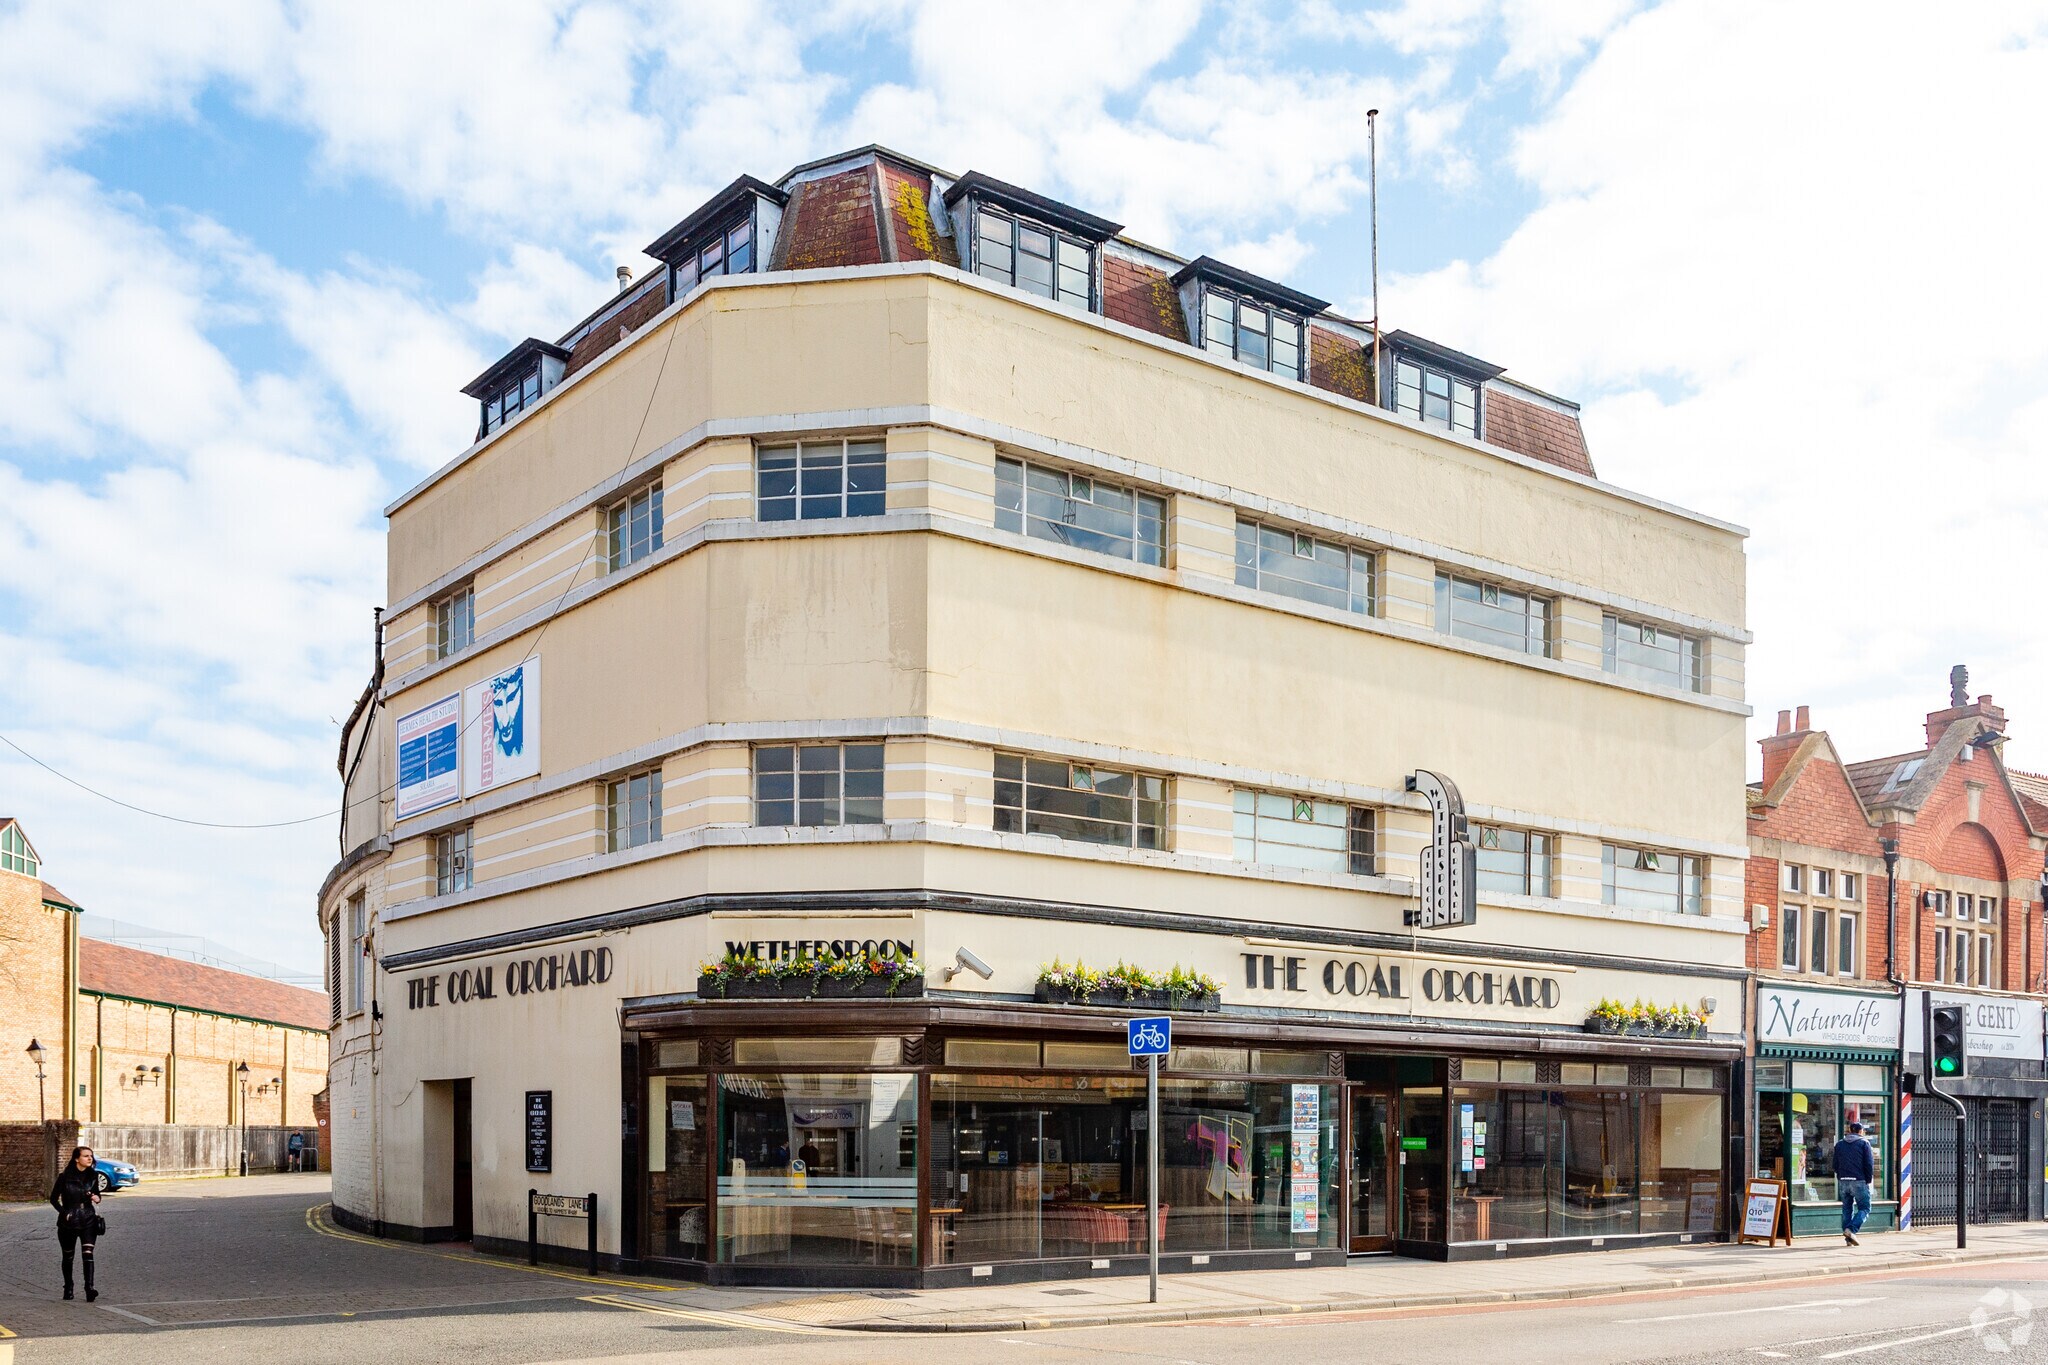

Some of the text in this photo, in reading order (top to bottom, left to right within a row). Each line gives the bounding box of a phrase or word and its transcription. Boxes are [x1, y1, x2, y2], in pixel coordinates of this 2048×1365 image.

[400, 701, 458, 735] HERMES HEALTH STUDIO
[482, 691, 494, 784] HERMES
[1430, 788, 1446, 920] WETHERSPOON
[725, 939, 914, 962] WETHERSPOON
[406, 946, 614, 1010] THE COAL ORCHARD
[1240, 953, 1561, 1009] THE COAL ORCHARD
[1766, 995, 1880, 1037] Naturalife
[1977, 1004, 2016, 1030] GENT
[1822, 1033, 1896, 1044] WHOLEFOODS BODYCARE
[533, 1195, 582, 1209] GOODLANDS LANE
[1748, 1208, 1763, 1216] Q10
